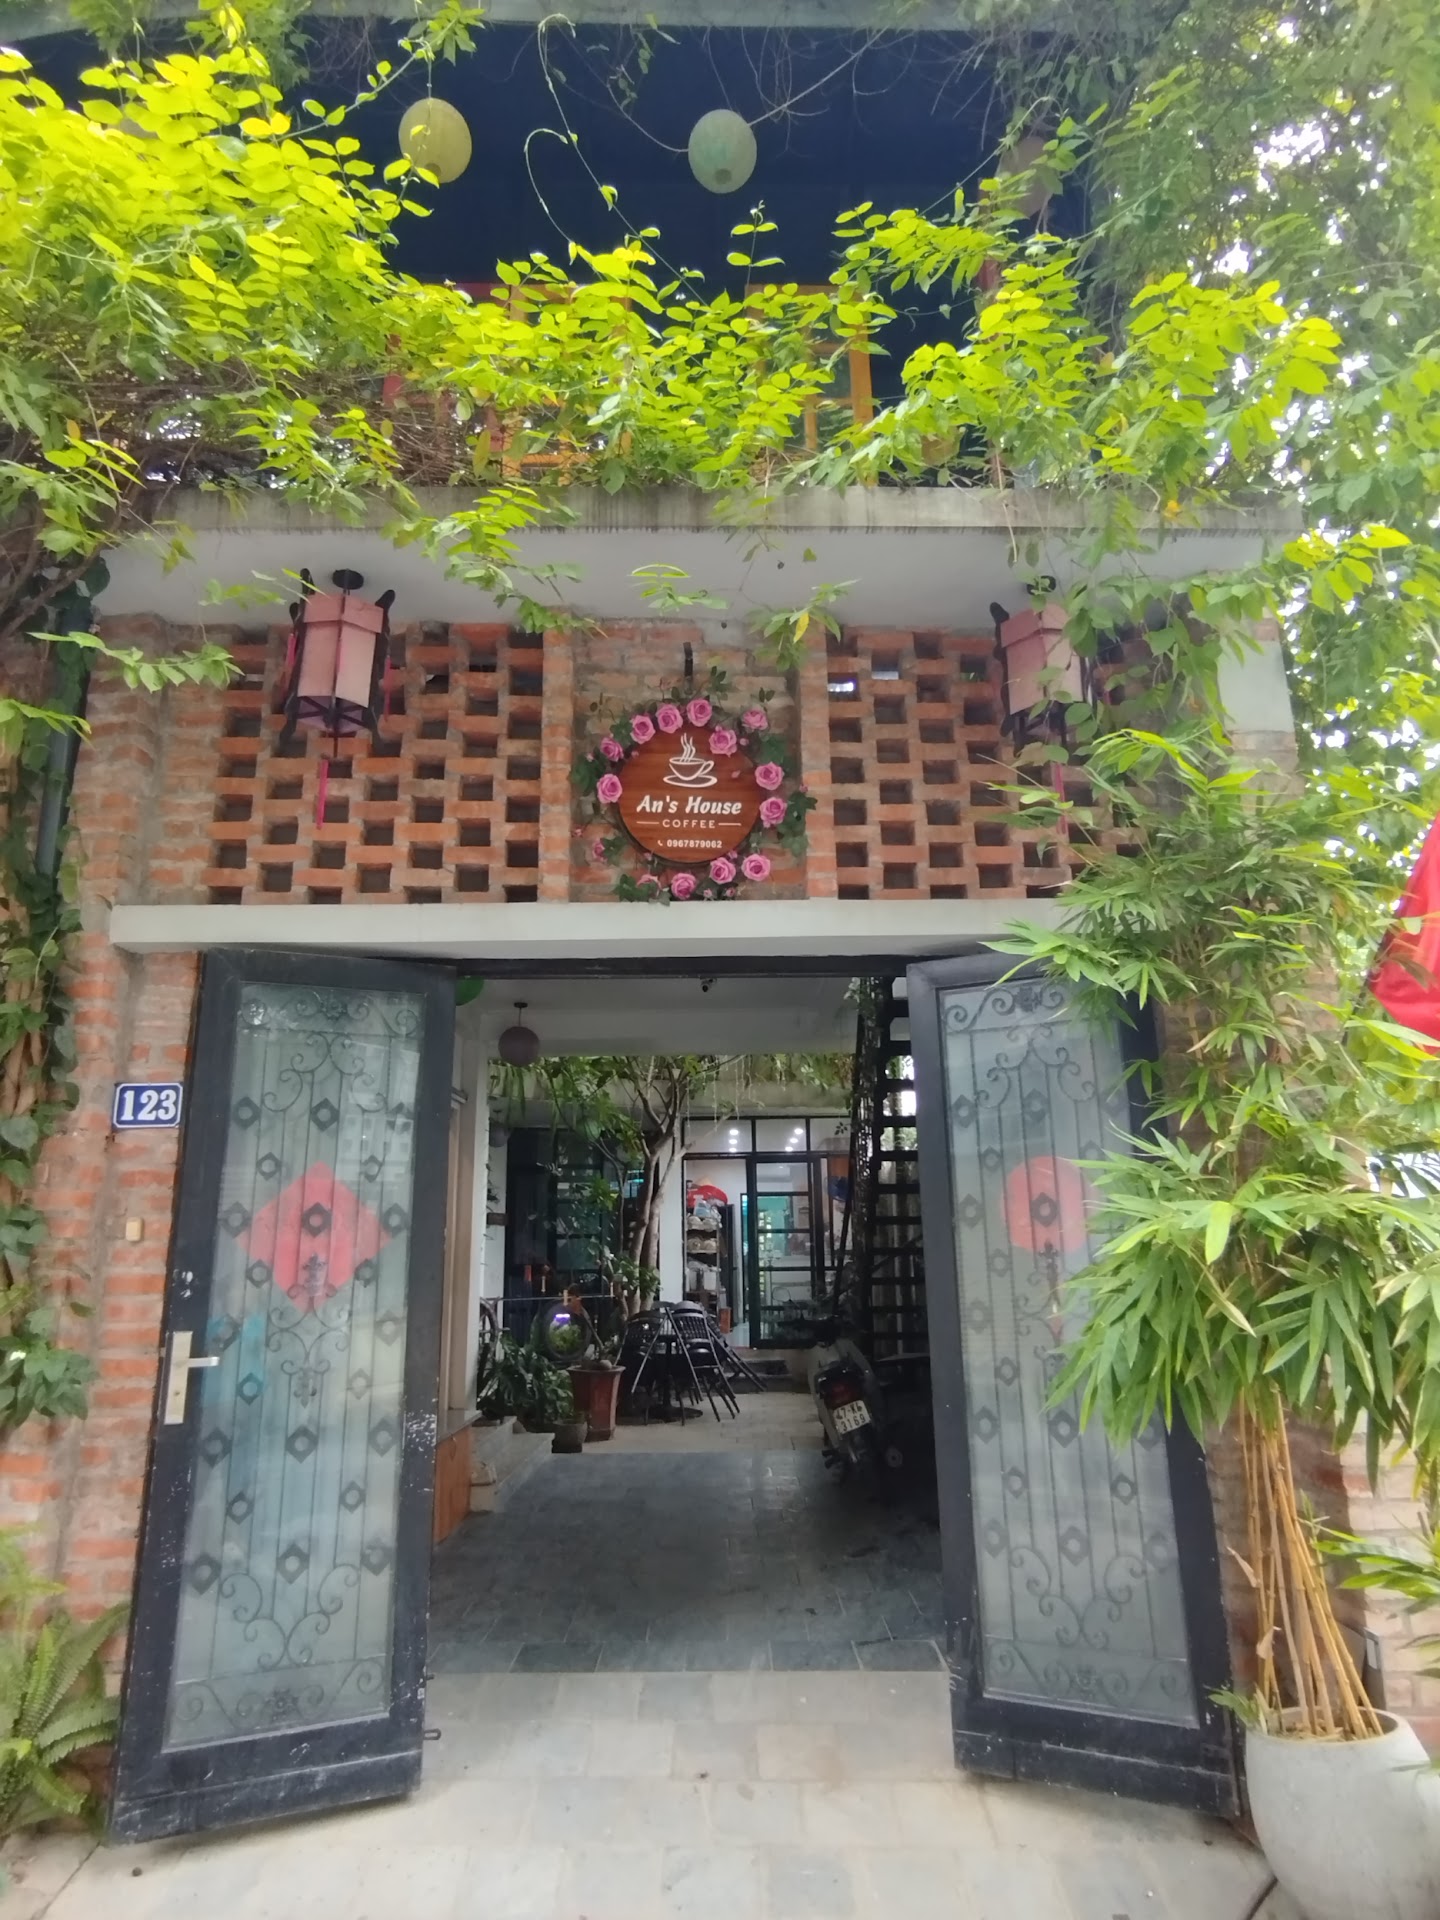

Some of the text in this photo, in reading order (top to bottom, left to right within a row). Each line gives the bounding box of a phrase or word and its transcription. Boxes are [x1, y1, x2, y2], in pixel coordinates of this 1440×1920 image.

[636, 794, 742, 815] An's House
[662, 819, 716, 828] COFFEE
[667, 839, 722, 848] 0967879062
[120, 1089, 177, 1121] 123
[840, 1413, 866, 1432] 3169
